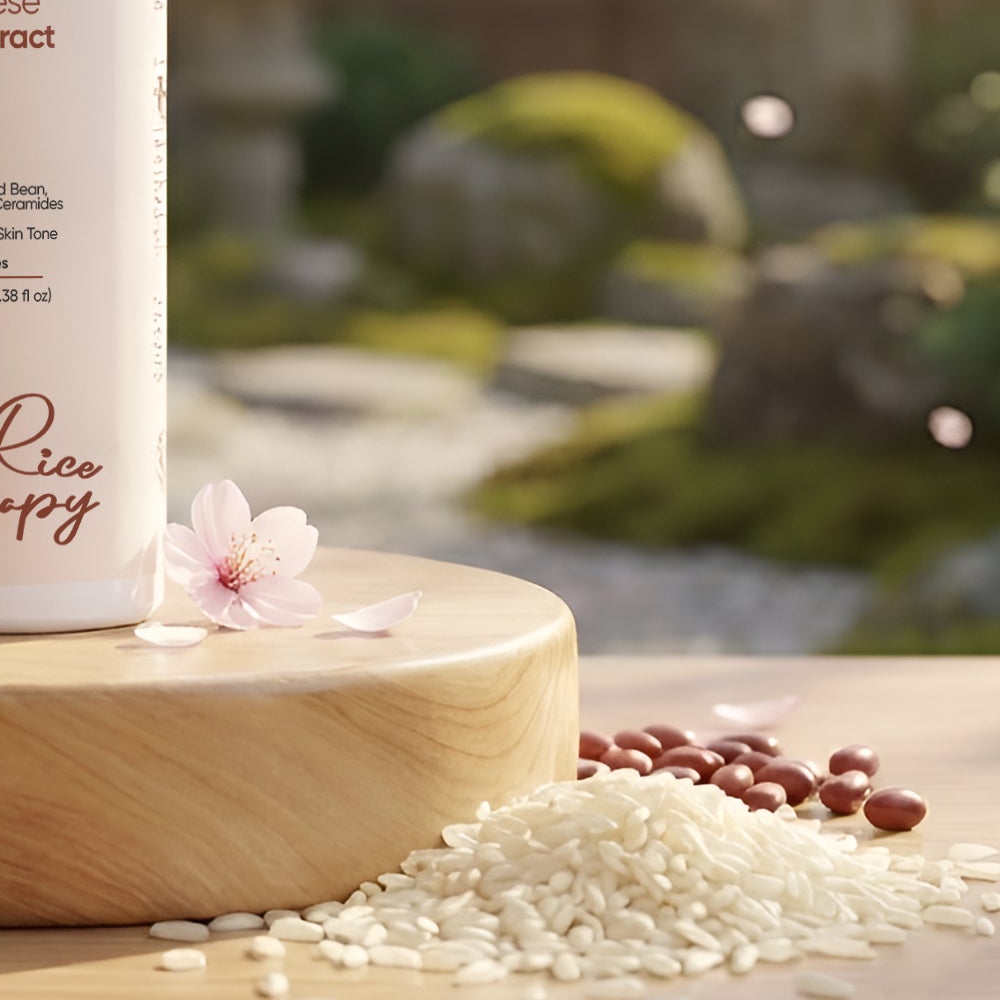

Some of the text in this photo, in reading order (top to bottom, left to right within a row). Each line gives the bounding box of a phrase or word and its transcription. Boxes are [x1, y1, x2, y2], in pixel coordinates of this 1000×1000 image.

[10, 182, 48, 198] Bean,
[26, 227, 59, 241] Tone
[22, 288, 30, 303] fl
[33, 287, 52, 304] oz)
